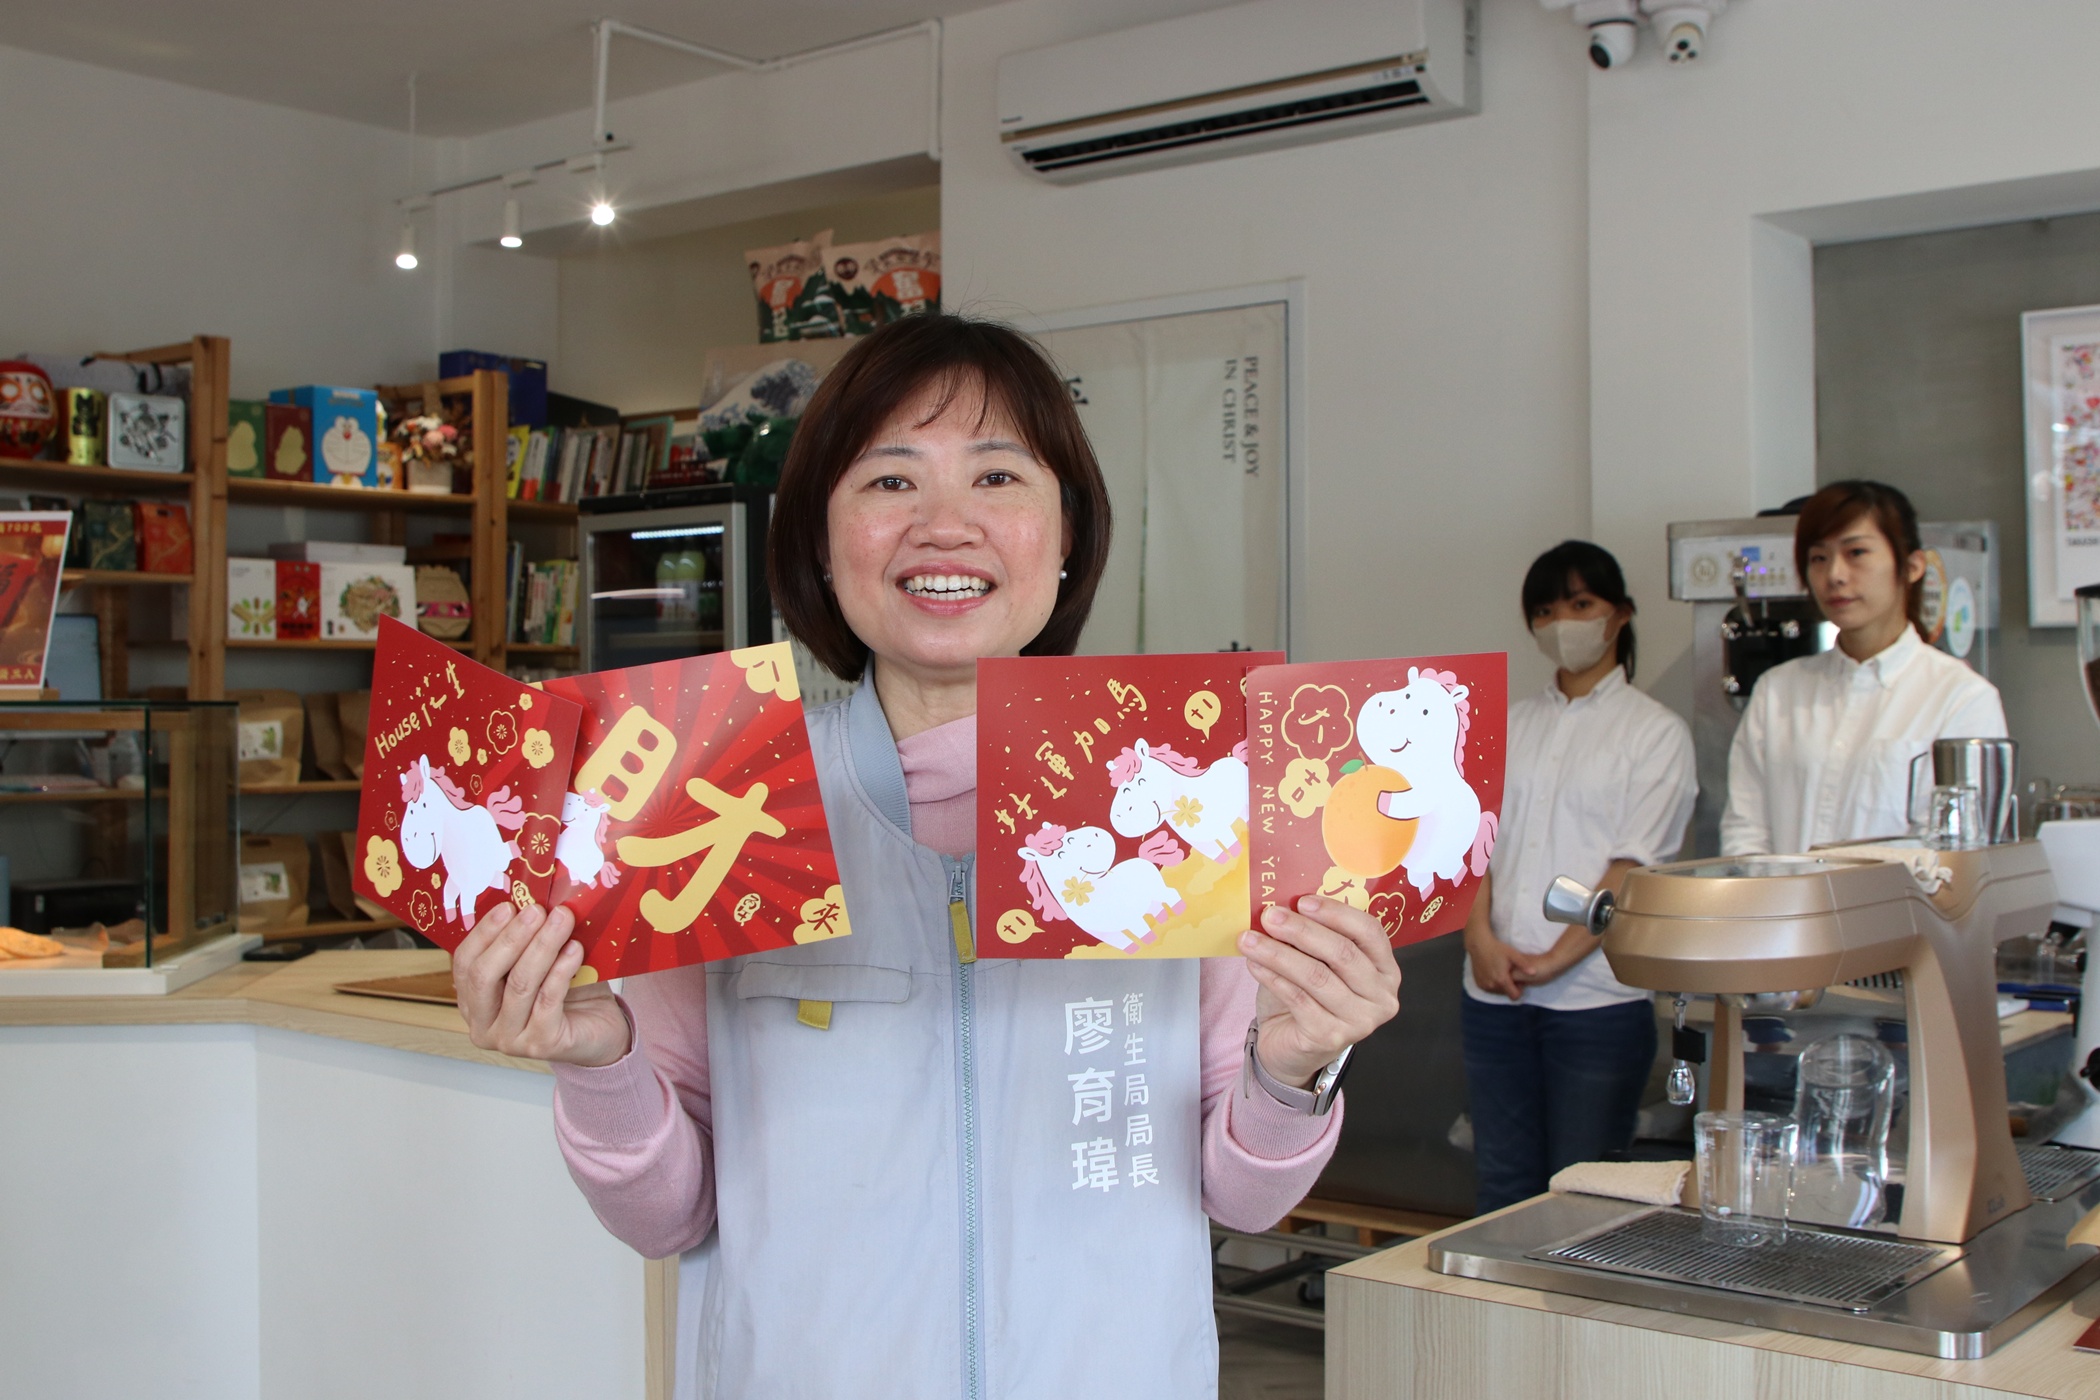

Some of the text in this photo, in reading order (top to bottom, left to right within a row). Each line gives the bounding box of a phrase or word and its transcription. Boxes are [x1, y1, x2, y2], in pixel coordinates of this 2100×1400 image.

[1222, 359, 1238, 463] IN CHRIST
[1240, 356, 1259, 477] PEACE & JOY
[994, 678, 1148, 835] 好運加馬
[1258, 691, 1274, 763] HAPPY
[1260, 786, 1276, 834] NEW
[1063, 997, 1119, 1193] 廖育瑋
[1122, 992, 1160, 1189] 衛生局局長
